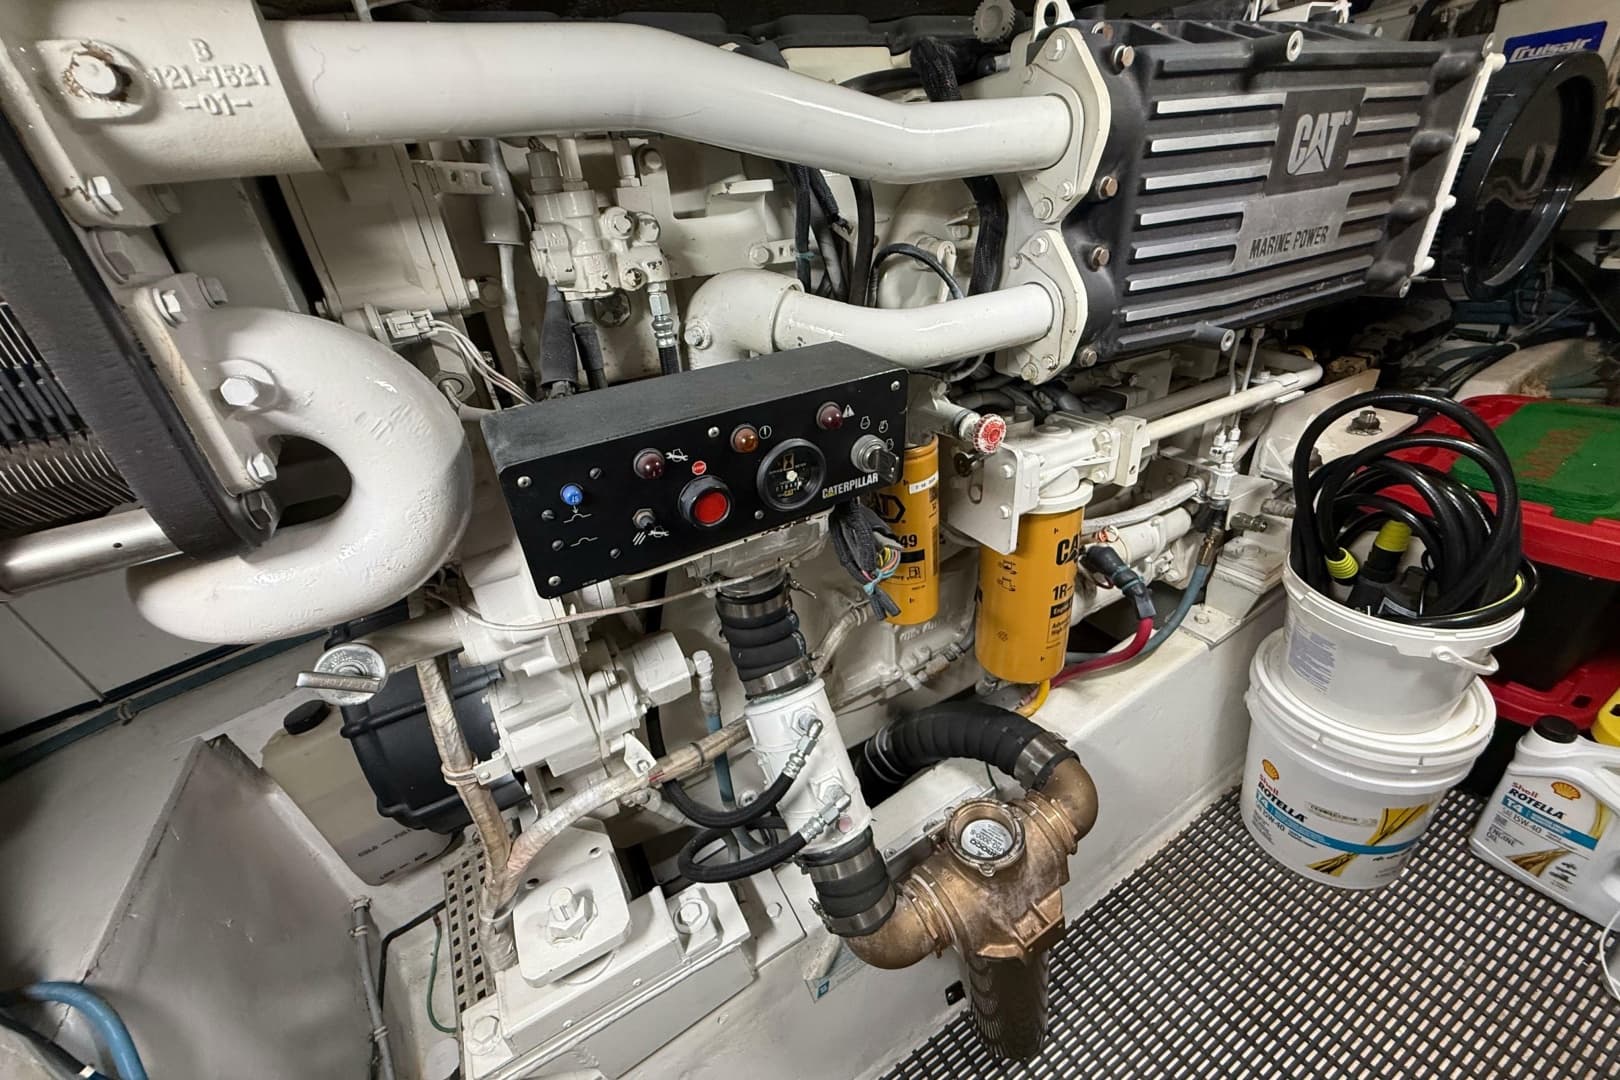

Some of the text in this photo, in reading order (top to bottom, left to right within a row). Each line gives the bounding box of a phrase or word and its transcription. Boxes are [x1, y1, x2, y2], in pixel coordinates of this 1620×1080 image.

[1509, 37, 1593, 63] Cruisair
[1286, 110, 1348, 176] CAT
[1249, 225, 1330, 260] MARINE POWER
[822, 472, 880, 500] CATERPILLAR
[1055, 532, 1082, 566] CA
[1258, 780, 1306, 823] ROTELLA
[1508, 787, 1565, 821] ROTELLA
[1512, 781, 1539, 799] Shell
